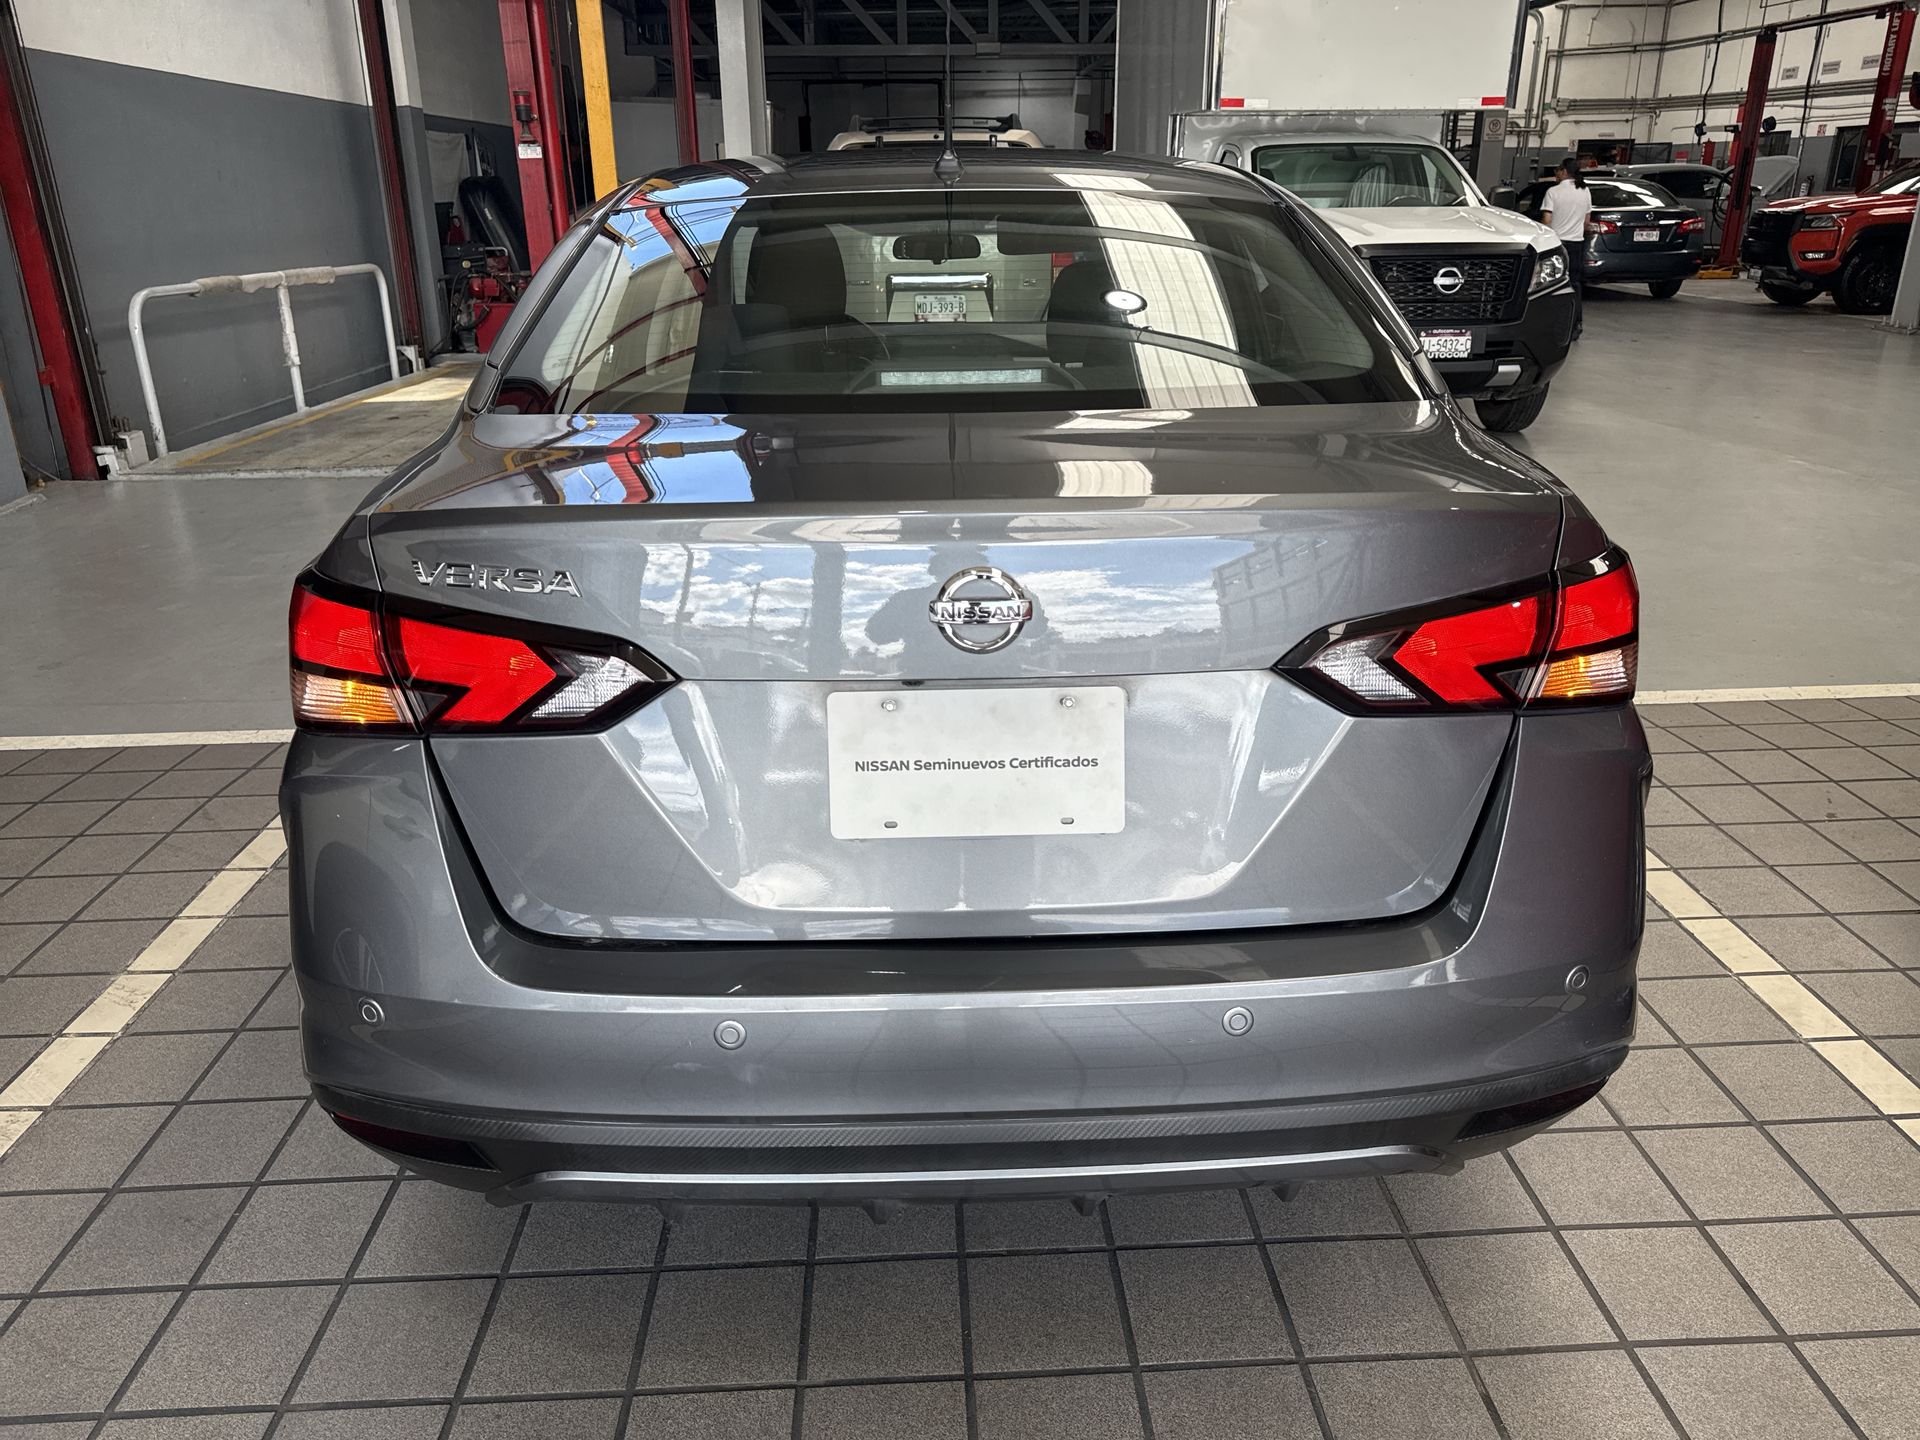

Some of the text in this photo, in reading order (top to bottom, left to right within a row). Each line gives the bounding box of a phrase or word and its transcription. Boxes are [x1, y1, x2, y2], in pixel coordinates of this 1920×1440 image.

[1883, 12, 1902, 71] ROTARY LIFT
[916, 301, 964, 314] MDJ-393-B
[411, 560, 582, 597] VERSA
[939, 603, 1021, 619] NISSAN
[855, 755, 1099, 772] NISSAN Seminuevos Certificados
